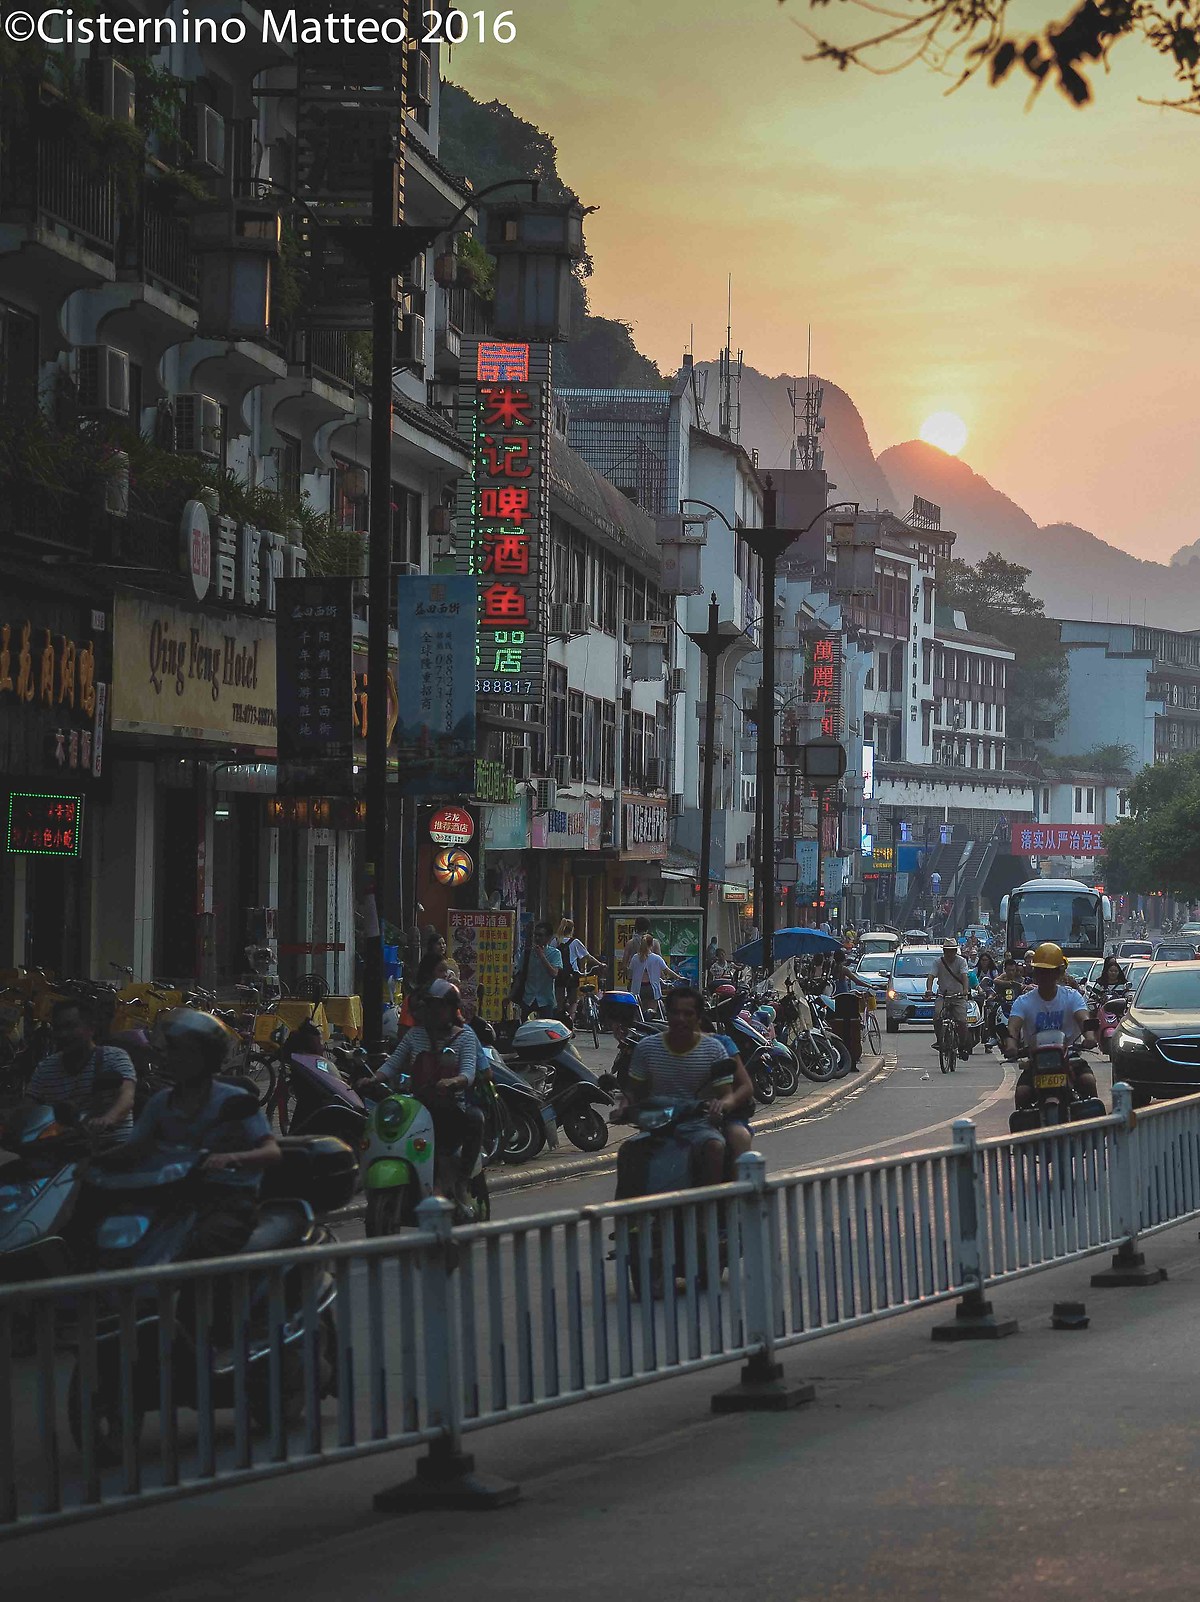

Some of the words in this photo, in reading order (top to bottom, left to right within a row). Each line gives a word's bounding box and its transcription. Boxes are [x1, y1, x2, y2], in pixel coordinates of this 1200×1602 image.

[481, 385, 534, 625] 朱记啤酒鱼
[150, 619, 188, 697] Qing
[188, 627, 221, 702] Feng
[222, 635, 259, 691] Hotel
[452, 914, 509, 927] 朱记啤酒鱼
